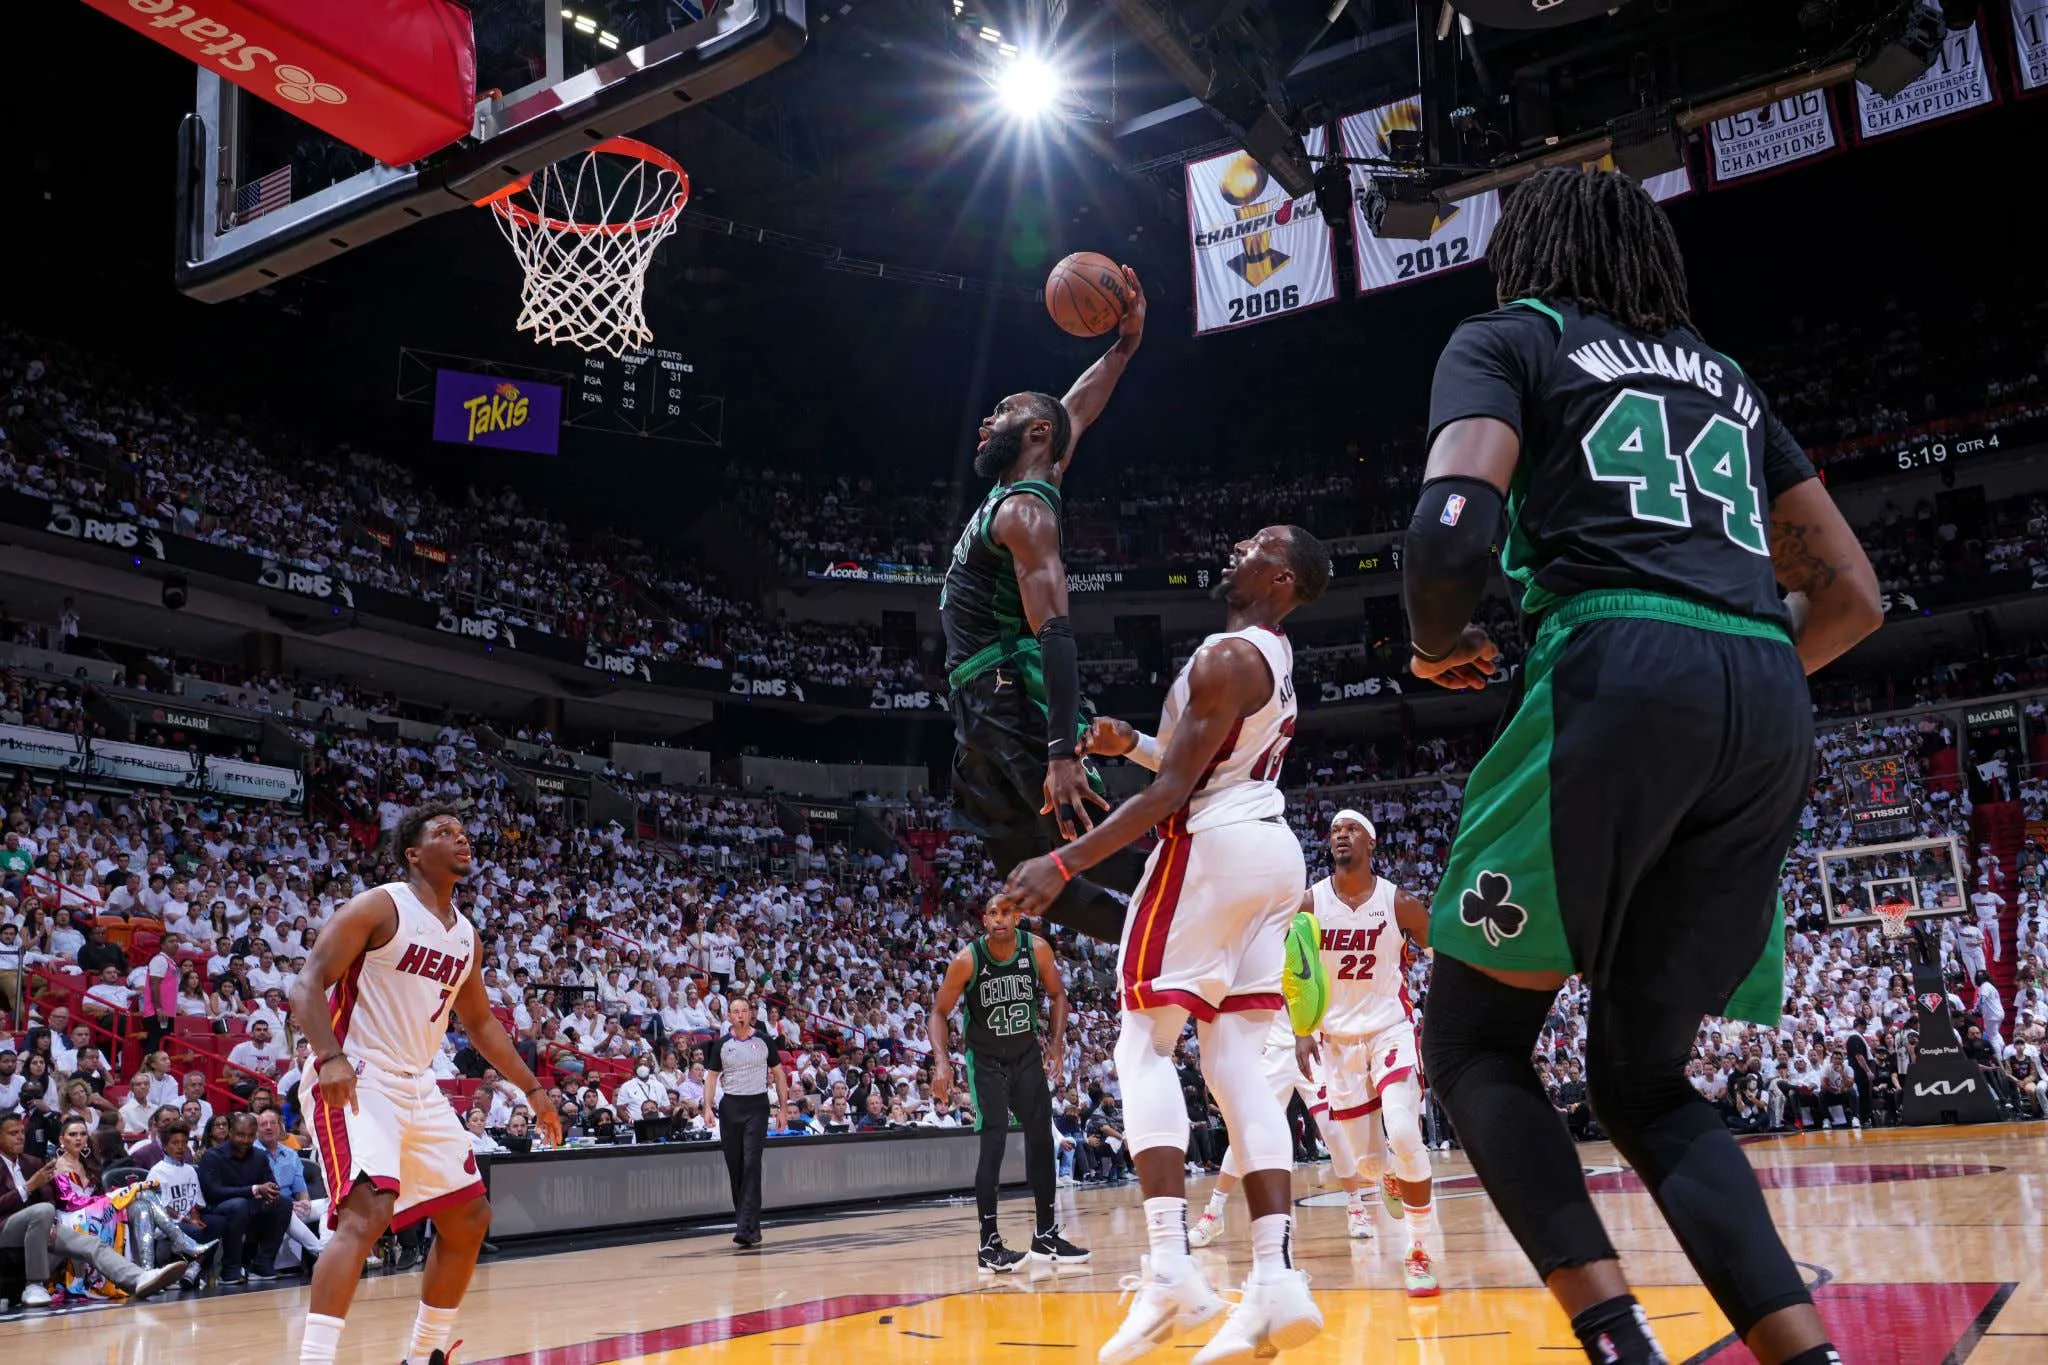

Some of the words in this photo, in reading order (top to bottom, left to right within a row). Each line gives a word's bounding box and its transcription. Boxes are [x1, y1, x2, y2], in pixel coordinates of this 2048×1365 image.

[128, 0, 278, 72] State
[1914, 69, 1978, 97] CONFERENCE
[1867, 83, 1983, 129] CHAMPIONS
[1720, 139, 1760, 155] EASTERN
[1763, 118, 1824, 143] CONFERENCE
[1721, 131, 1826, 173] CHAMPIONS
[1396, 236, 1470, 279] 2012
[1229, 285, 1299, 323] 2006
[657, 349, 682, 361] STATS
[661, 360, 694, 373] CELTICS
[585, 358, 605, 370] FGM
[624, 364, 637, 375] 27
[669, 371, 681, 383] 31
[1567, 339, 1724, 398] WILLIAMS
[1733, 384, 1761, 429] III
[584, 375, 602, 386] FGA
[623, 381, 635, 392] 84
[669, 388, 681, 399] 62
[463, 394, 529, 442] Takis
[622, 397, 634, 409] 32
[668, 404, 680, 415] 50
[1898, 443, 1947, 469] 5:19
[1956, 439, 1985, 453] QTR
[1989, 433, 2000, 447] 4
[1581, 388, 1770, 556] 44
[823, 561, 868, 579] Acordis
[873, 572, 913, 584] Technology
[1359, 558, 1378, 569] AST
[1066, 582, 1105, 592] BROWN
[1168, 575, 1187, 584] MIN
[167, 713, 209, 730] BACARDÍ
[1967, 705, 2015, 724] BACARDÍ
[1870, 778, 1896, 804] 12
[1872, 806, 1910, 818] TISSOT
[1319, 920, 1388, 951] HEAT
[395, 943, 470, 988] HEAT
[1338, 954, 1377, 980] 22
[980, 974, 1034, 1008] CELTICS
[430, 988, 452, 1023] 7
[987, 1002, 1031, 1037] 42
[1919, 1047, 1943, 1056] Google
[1944, 1046, 1959, 1054] Pixel
[1914, 1079, 1976, 1097] KIA
[627, 1165, 711, 1210] DOWNLOAD
